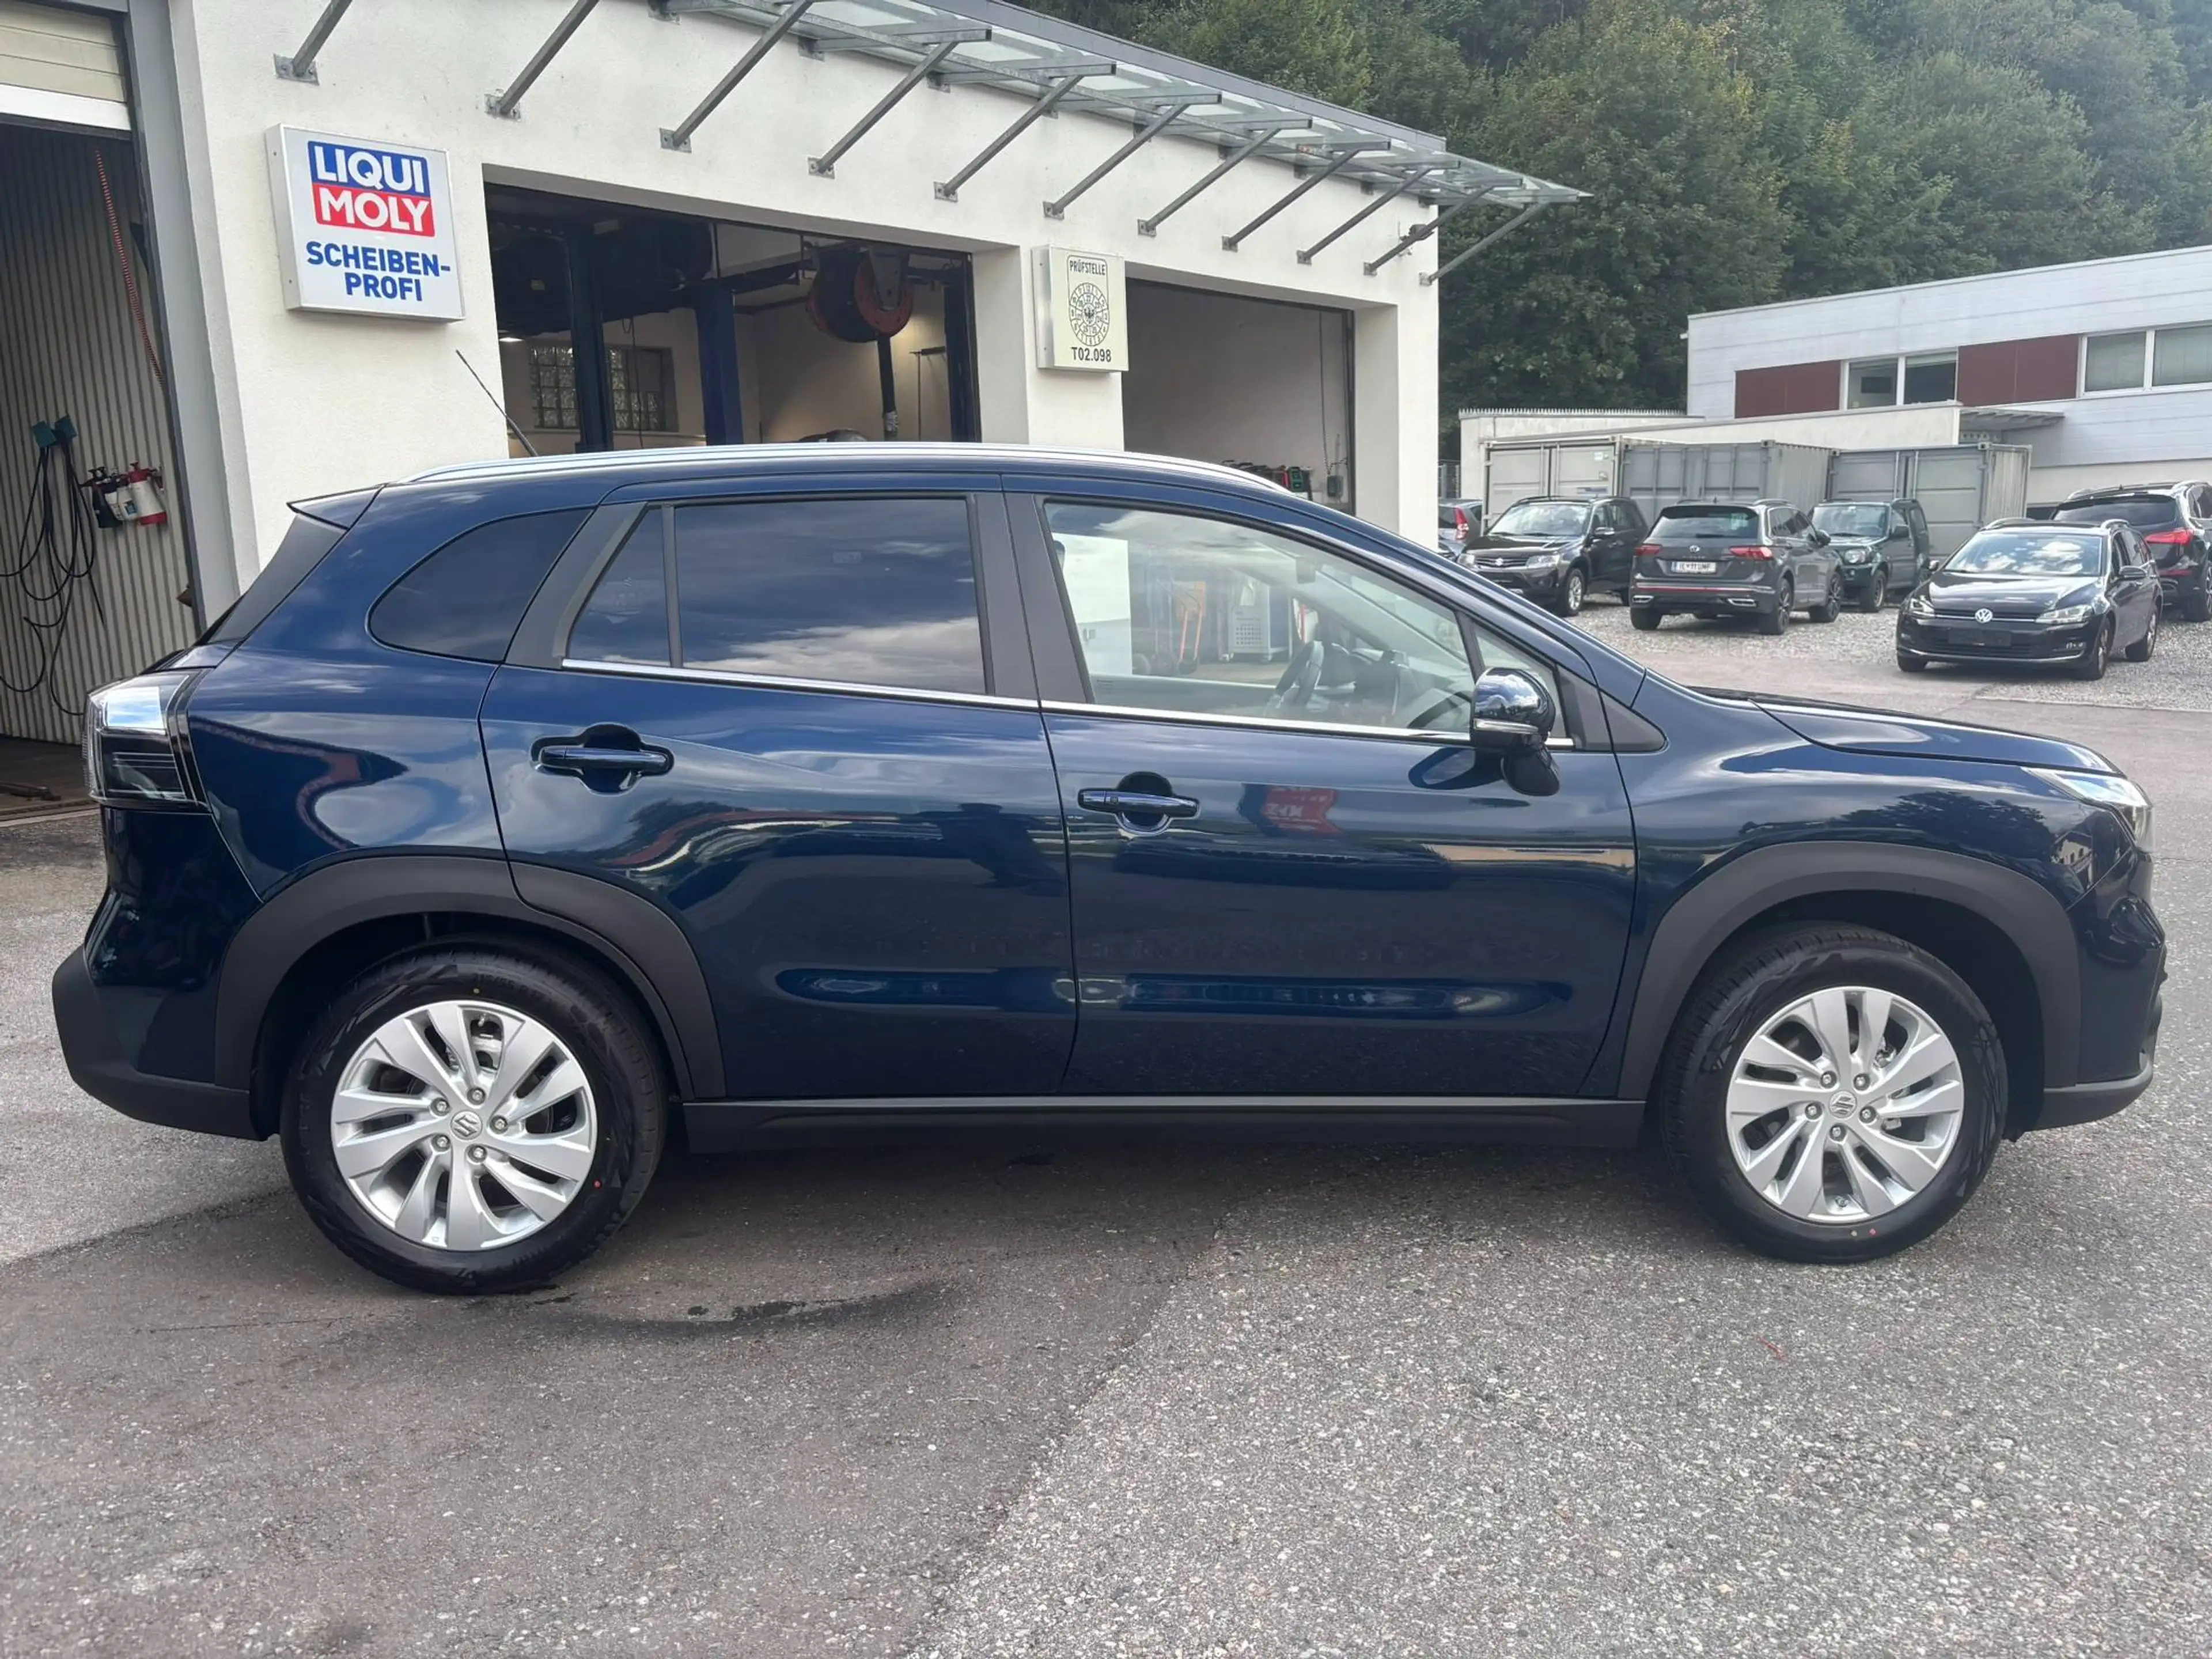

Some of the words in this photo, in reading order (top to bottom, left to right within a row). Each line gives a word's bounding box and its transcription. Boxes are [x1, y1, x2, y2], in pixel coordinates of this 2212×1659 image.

[314, 146, 425, 193] LIQUI
[319, 187, 429, 232] MOLY
[306, 241, 450, 276] SCHEIBEN-
[1070, 259, 1105, 275] PRÜFSTELLE
[344, 272, 422, 301] PROFI
[1071, 347, 1111, 363] T02.098
